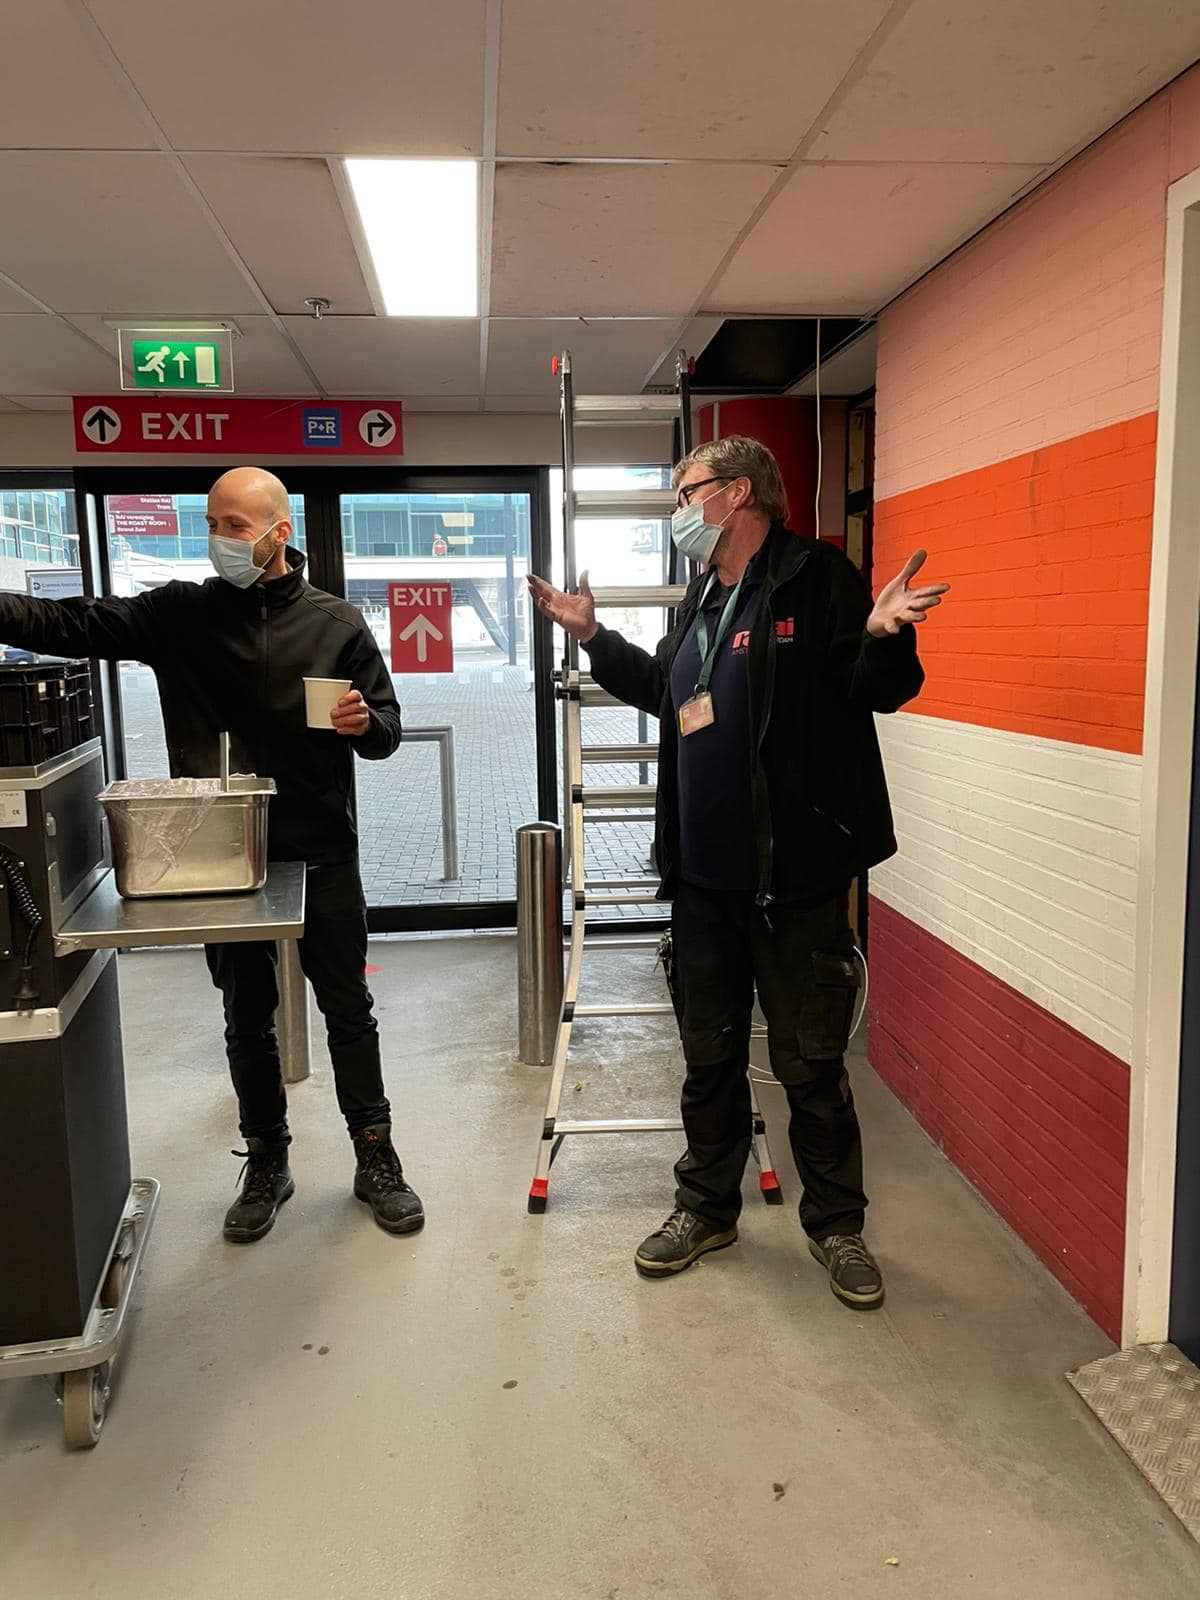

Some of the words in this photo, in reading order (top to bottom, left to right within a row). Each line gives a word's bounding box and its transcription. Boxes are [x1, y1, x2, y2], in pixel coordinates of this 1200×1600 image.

[141, 412, 230, 441] EXIT
[307, 420, 336, 434] P+R
[393, 587, 448, 606] EXIT
